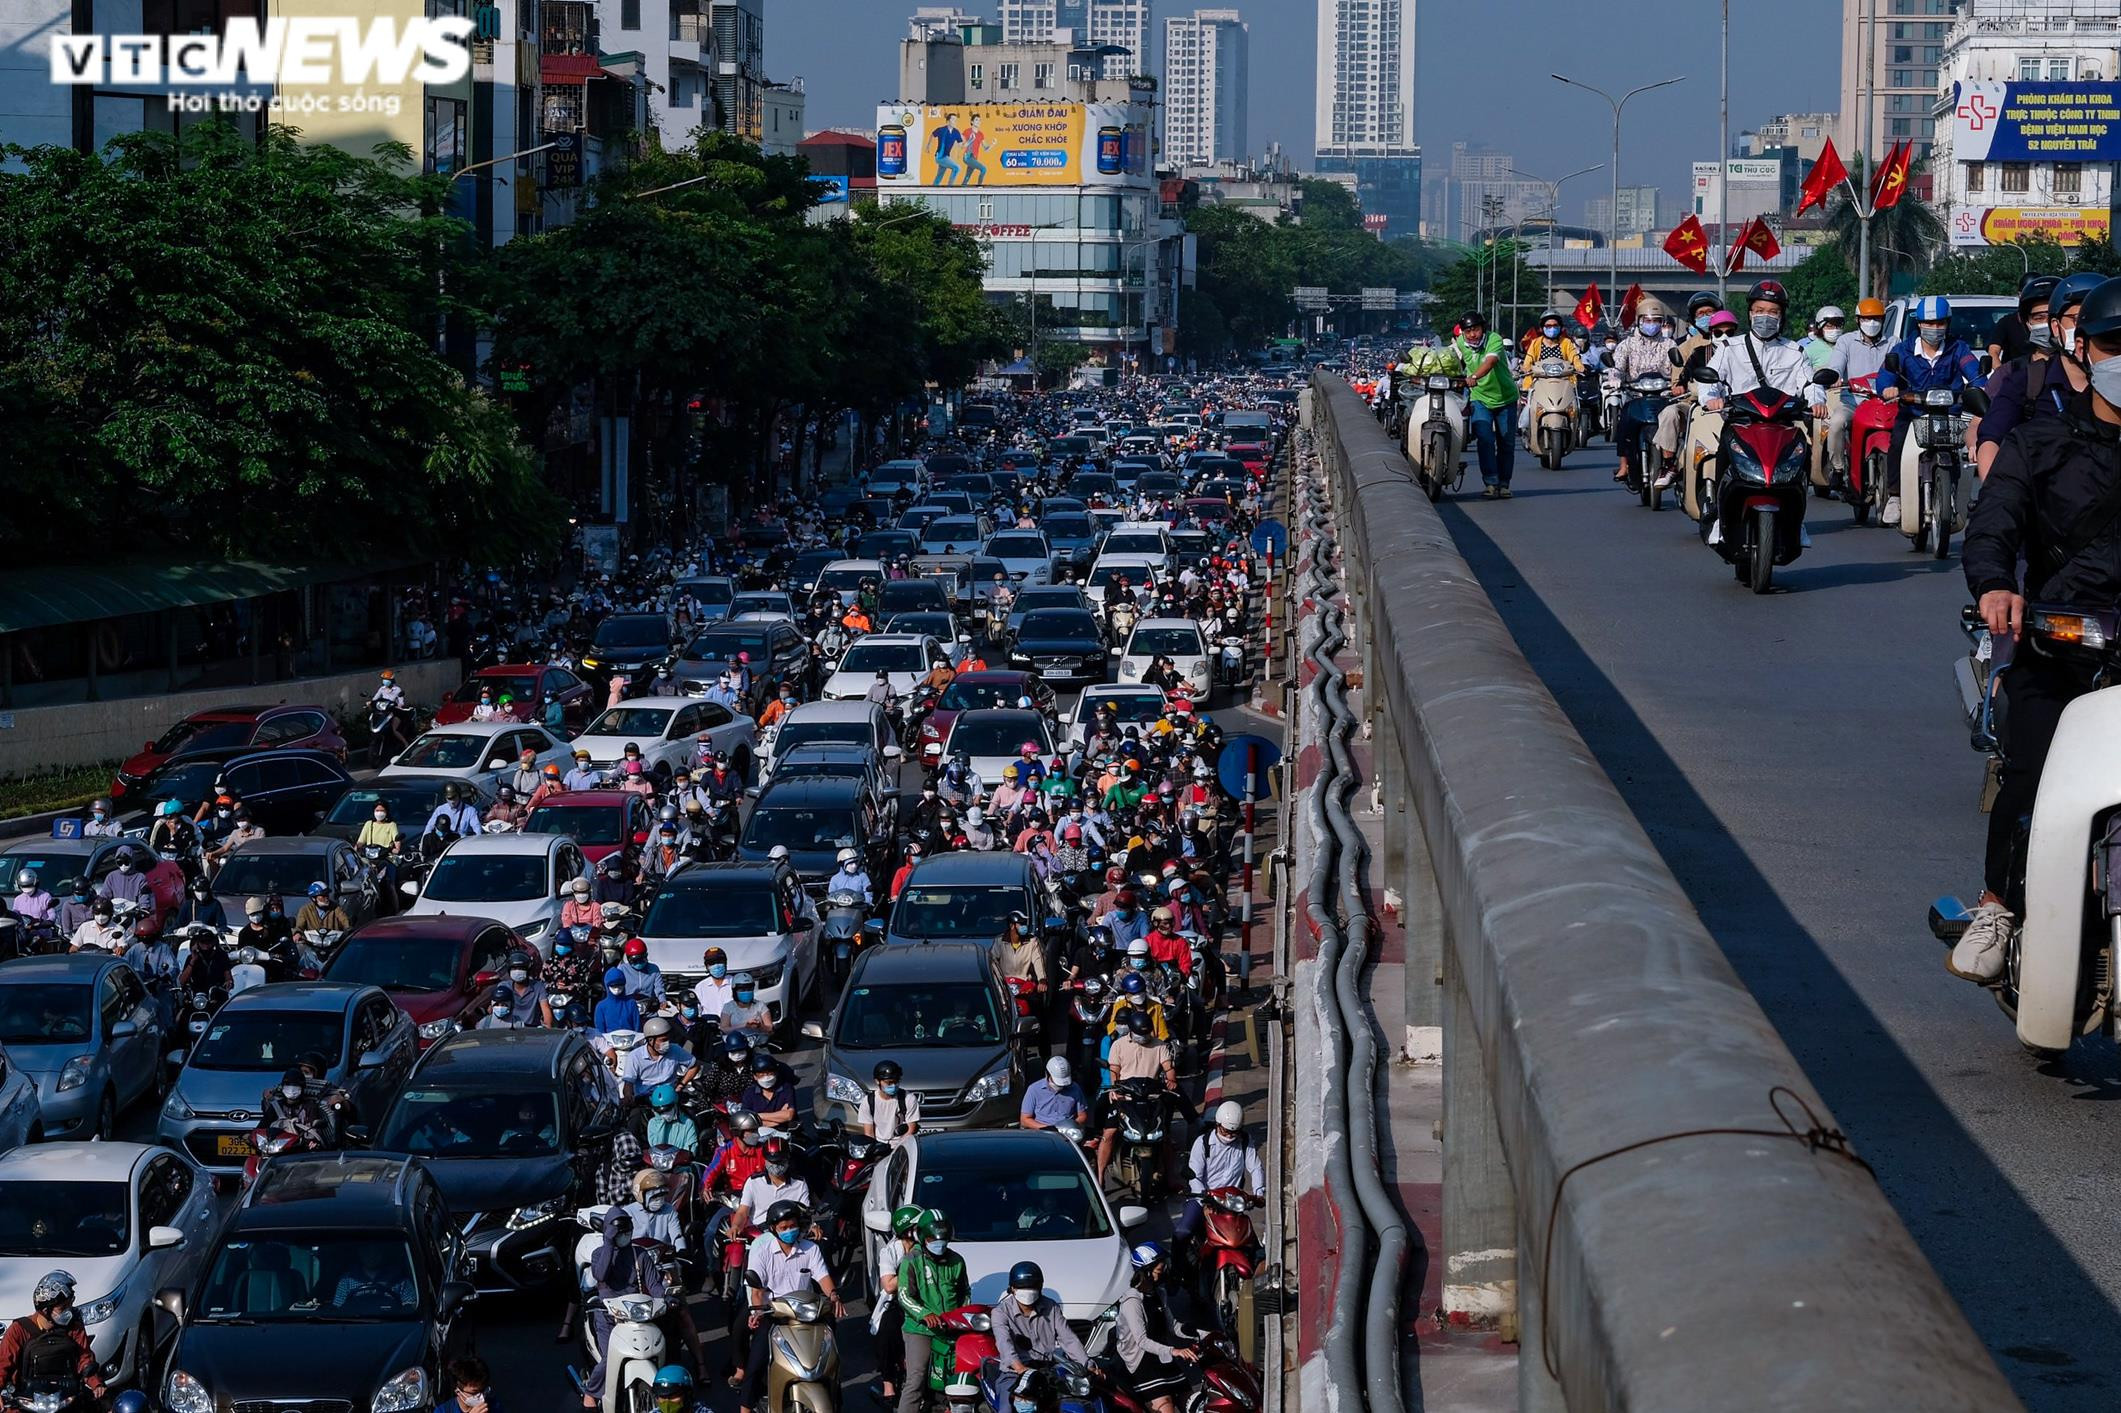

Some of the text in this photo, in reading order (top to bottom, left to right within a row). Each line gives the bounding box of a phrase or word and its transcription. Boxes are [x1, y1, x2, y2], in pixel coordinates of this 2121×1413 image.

[2016, 93, 2046, 105] PHÒNG
[2048, 93, 2074, 105] KHÁM
[2089, 94, 2112, 104] KHOA
[1018, 106, 1044, 118] GIẢM
[2060, 108, 2083, 120] CÔNG
[2085, 109, 2096, 119] TY
[2020, 123, 2108, 136] BỆNH VIỆN NAM HỌC
[882, 141, 903, 157] JEX
[1102, 141, 1119, 155] JEX
[2027, 140, 2039, 150] 52
[2040, 137, 2076, 150] NGUYỄN
[1005, 158, 1017, 167] 60
[554, 164, 576, 174] VIP
